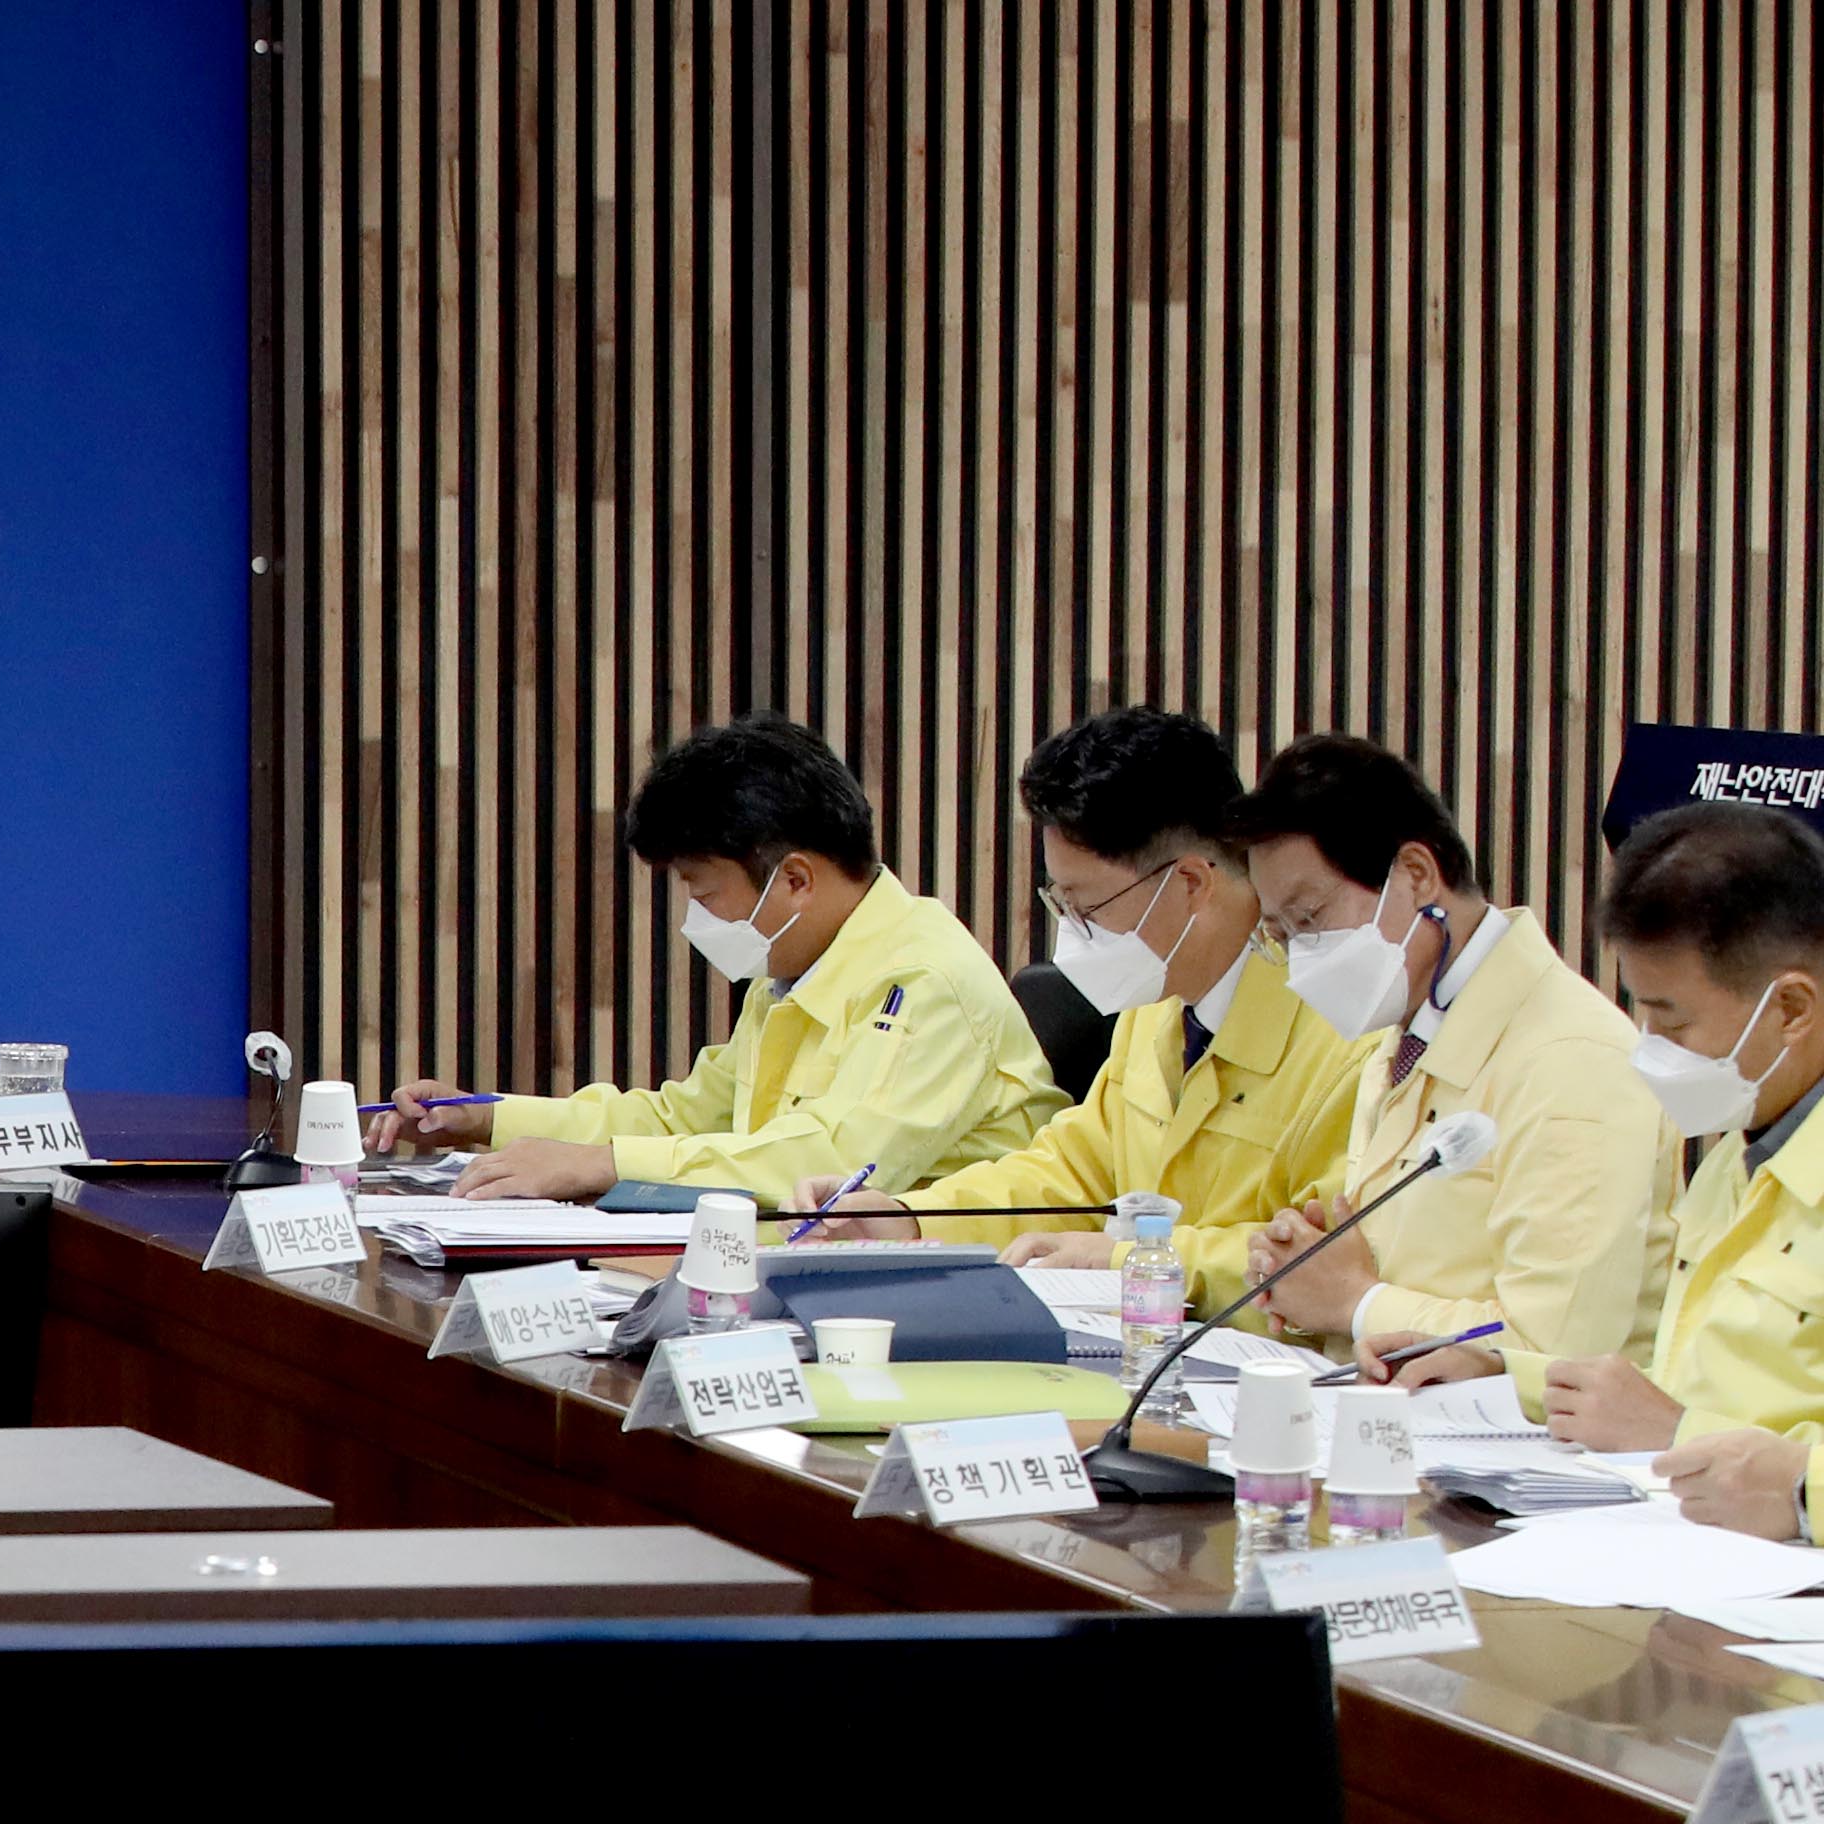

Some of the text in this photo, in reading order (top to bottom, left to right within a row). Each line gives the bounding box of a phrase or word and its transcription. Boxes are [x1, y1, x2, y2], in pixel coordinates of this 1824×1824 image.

[1690, 762, 1824, 808] 재난안전대
[256, 1213, 357, 1258] 기획조정실
[488, 1297, 595, 1346] 해양수산국
[687, 1367, 806, 1417] 전략산업국
[923, 1453, 1088, 1505] 정책기획관
